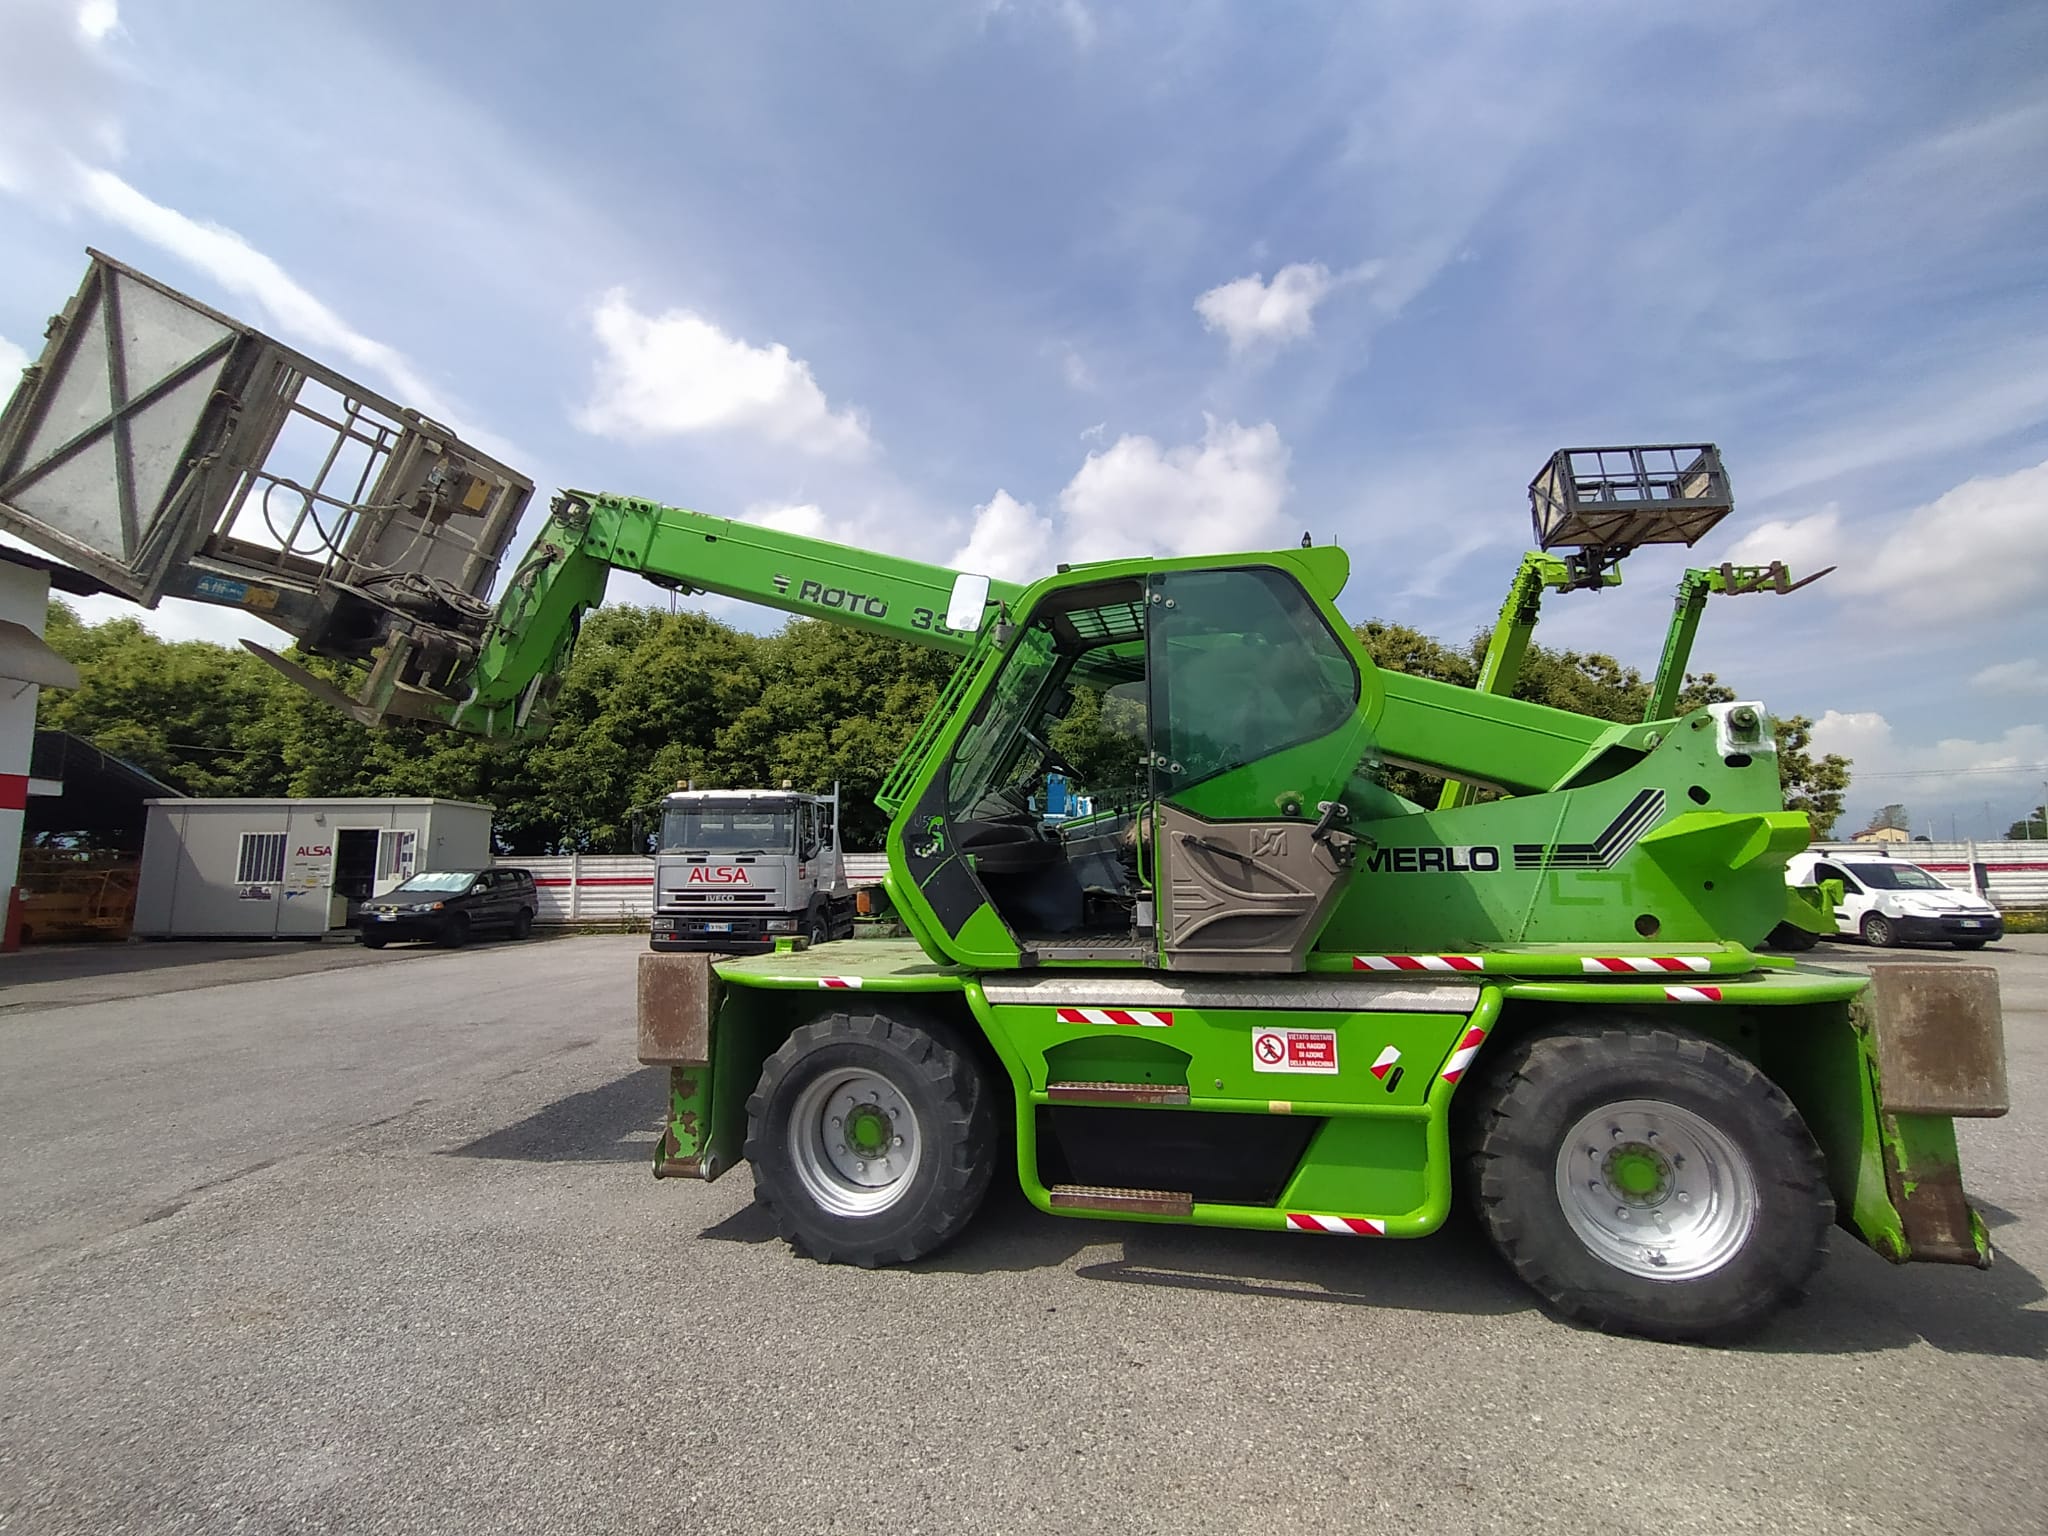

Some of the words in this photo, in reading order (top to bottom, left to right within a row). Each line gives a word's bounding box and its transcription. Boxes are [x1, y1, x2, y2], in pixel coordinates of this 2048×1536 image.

[800, 580, 888, 618] ROTO
[296, 846, 332, 856] ALSA
[1360, 846, 1500, 873] MERLO
[688, 866, 749, 883] ALSA
